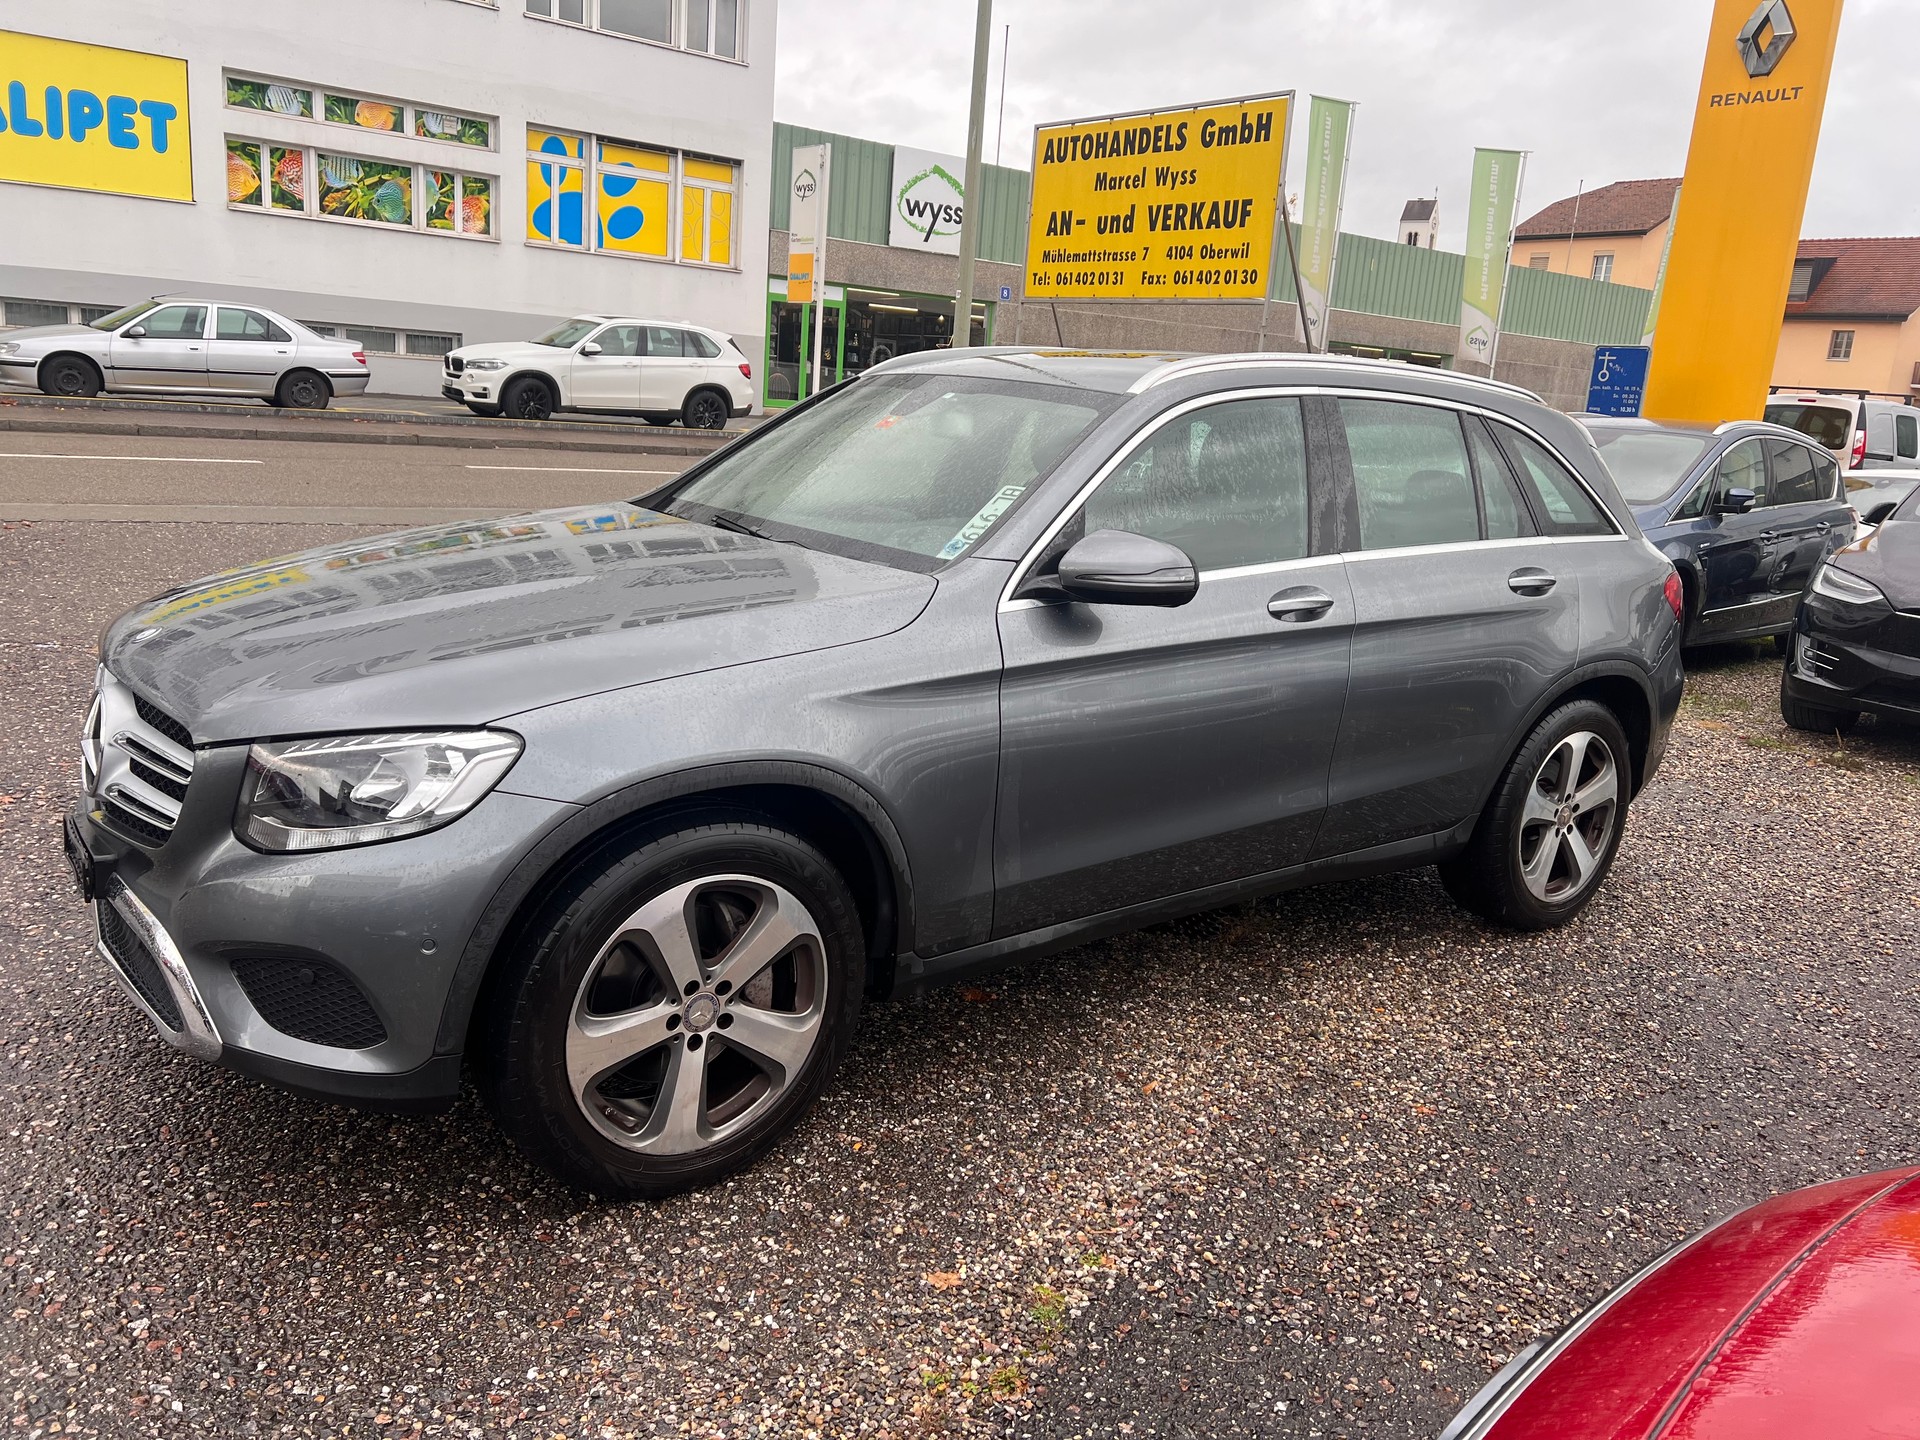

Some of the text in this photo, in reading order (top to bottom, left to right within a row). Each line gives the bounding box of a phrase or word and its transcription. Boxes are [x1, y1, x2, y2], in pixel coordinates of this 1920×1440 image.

[1710, 86, 1804, 108] RENAULT
[0, 80, 178, 154] LIPET
[1042, 111, 1273, 164] AUTOHANDELS GmbH
[1094, 166, 1198, 192] Marcel Wyss
[1046, 198, 1253, 237] AN- und VERKAUF
[1042, 242, 1250, 264] Mühlemattstrasse 7 4104 Oberwil
[1032, 272, 1051, 286] Tel:
[1141, 270, 1167, 286] Fax:
[1003, 289, 1008, 298] 8
